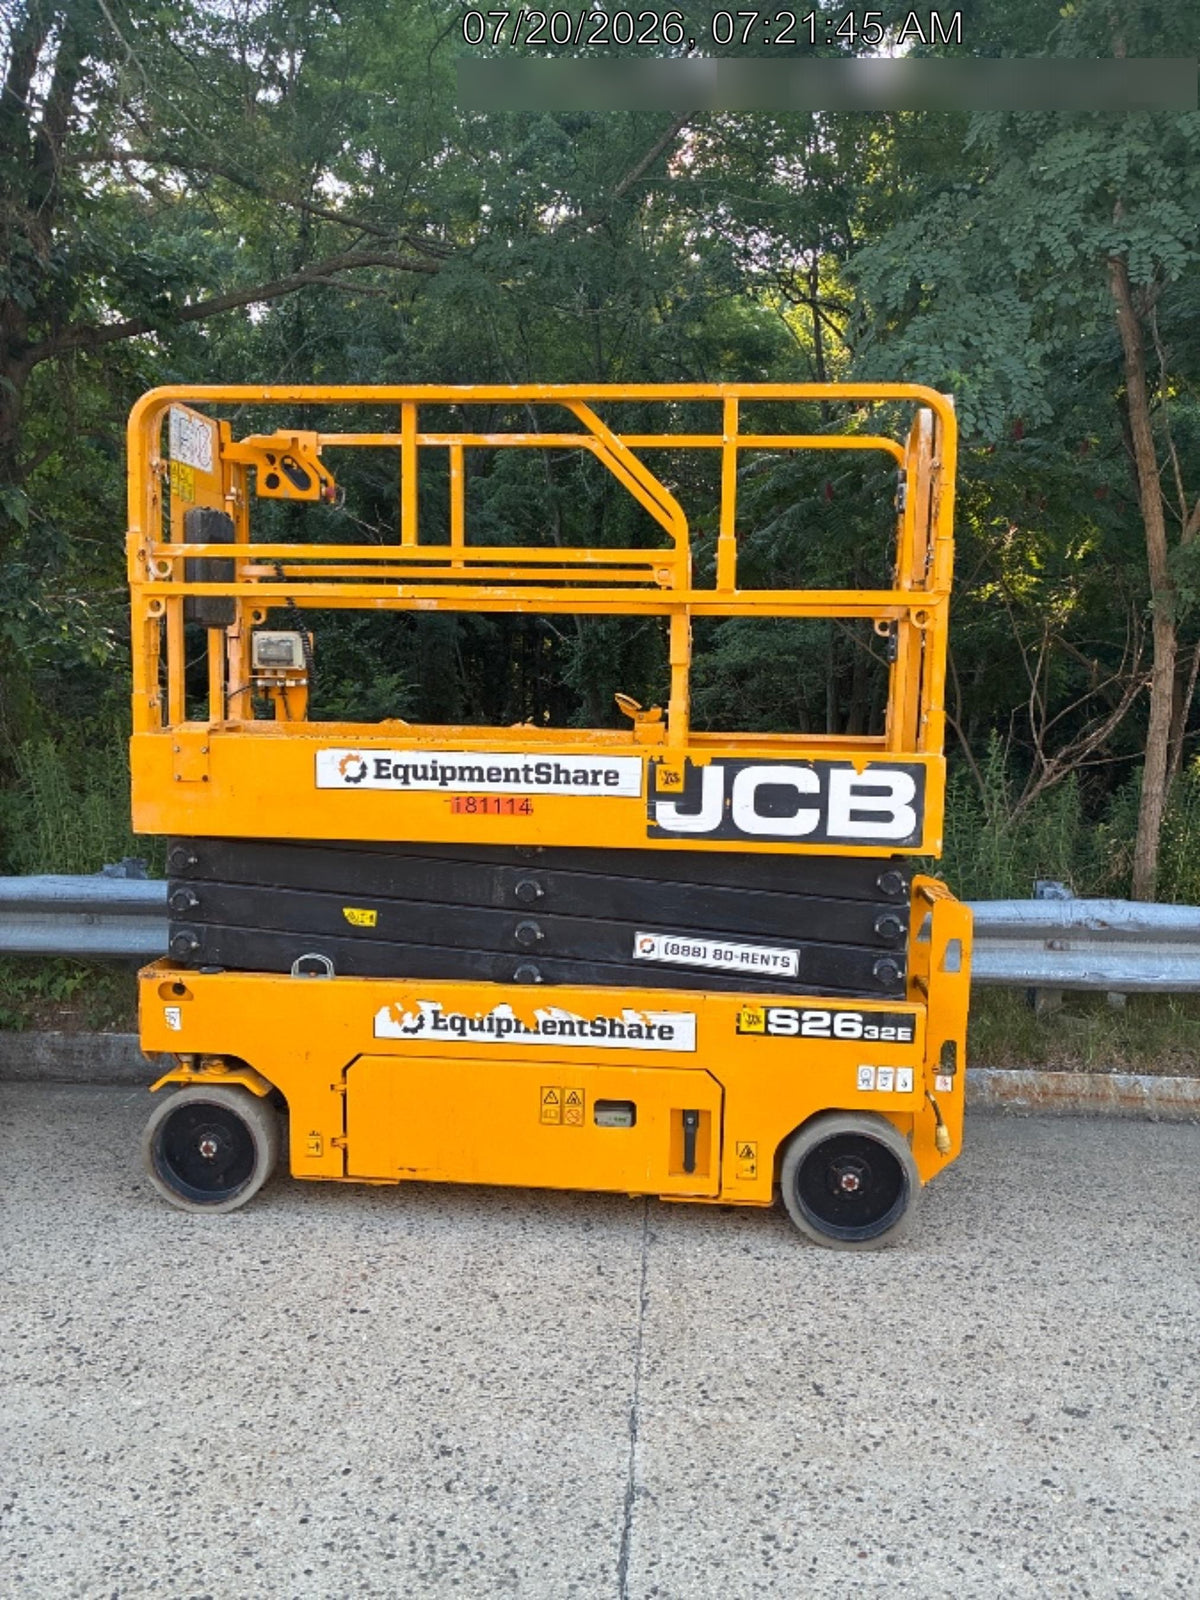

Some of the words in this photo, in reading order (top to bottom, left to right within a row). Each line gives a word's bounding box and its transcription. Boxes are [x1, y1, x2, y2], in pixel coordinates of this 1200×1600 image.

[373, 758, 620, 788] EquipmentShare
[655, 764, 917, 840] JCB
[664, 943, 707, 959] (888)
[712, 948, 790, 968] 80-RENTS
